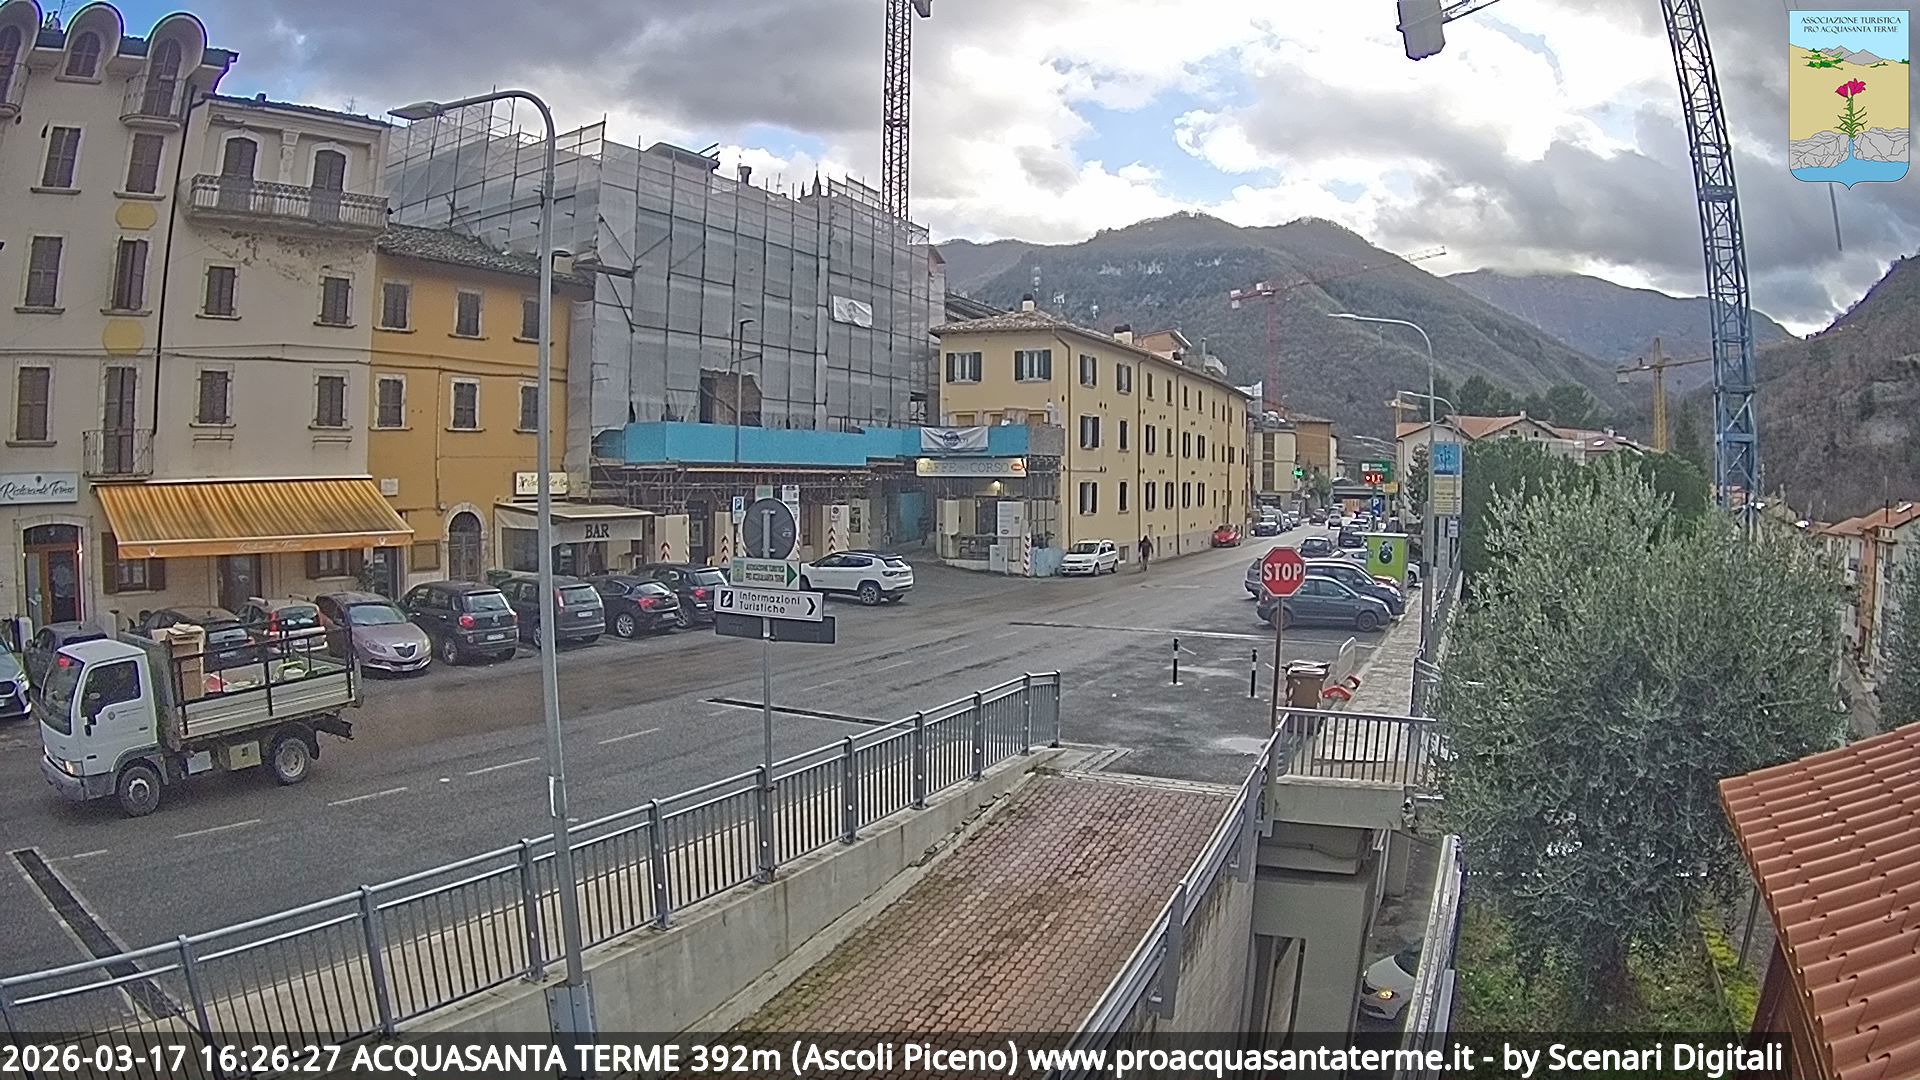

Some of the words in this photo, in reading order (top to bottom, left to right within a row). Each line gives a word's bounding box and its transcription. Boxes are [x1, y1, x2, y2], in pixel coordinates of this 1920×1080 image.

[969, 462, 1009, 473] CORSO
[584, 523, 611, 539] BAR
[1263, 562, 1302, 581] STOP
[739, 591, 800, 605] Informazioni
[740, 601, 786, 614] Turistiche
